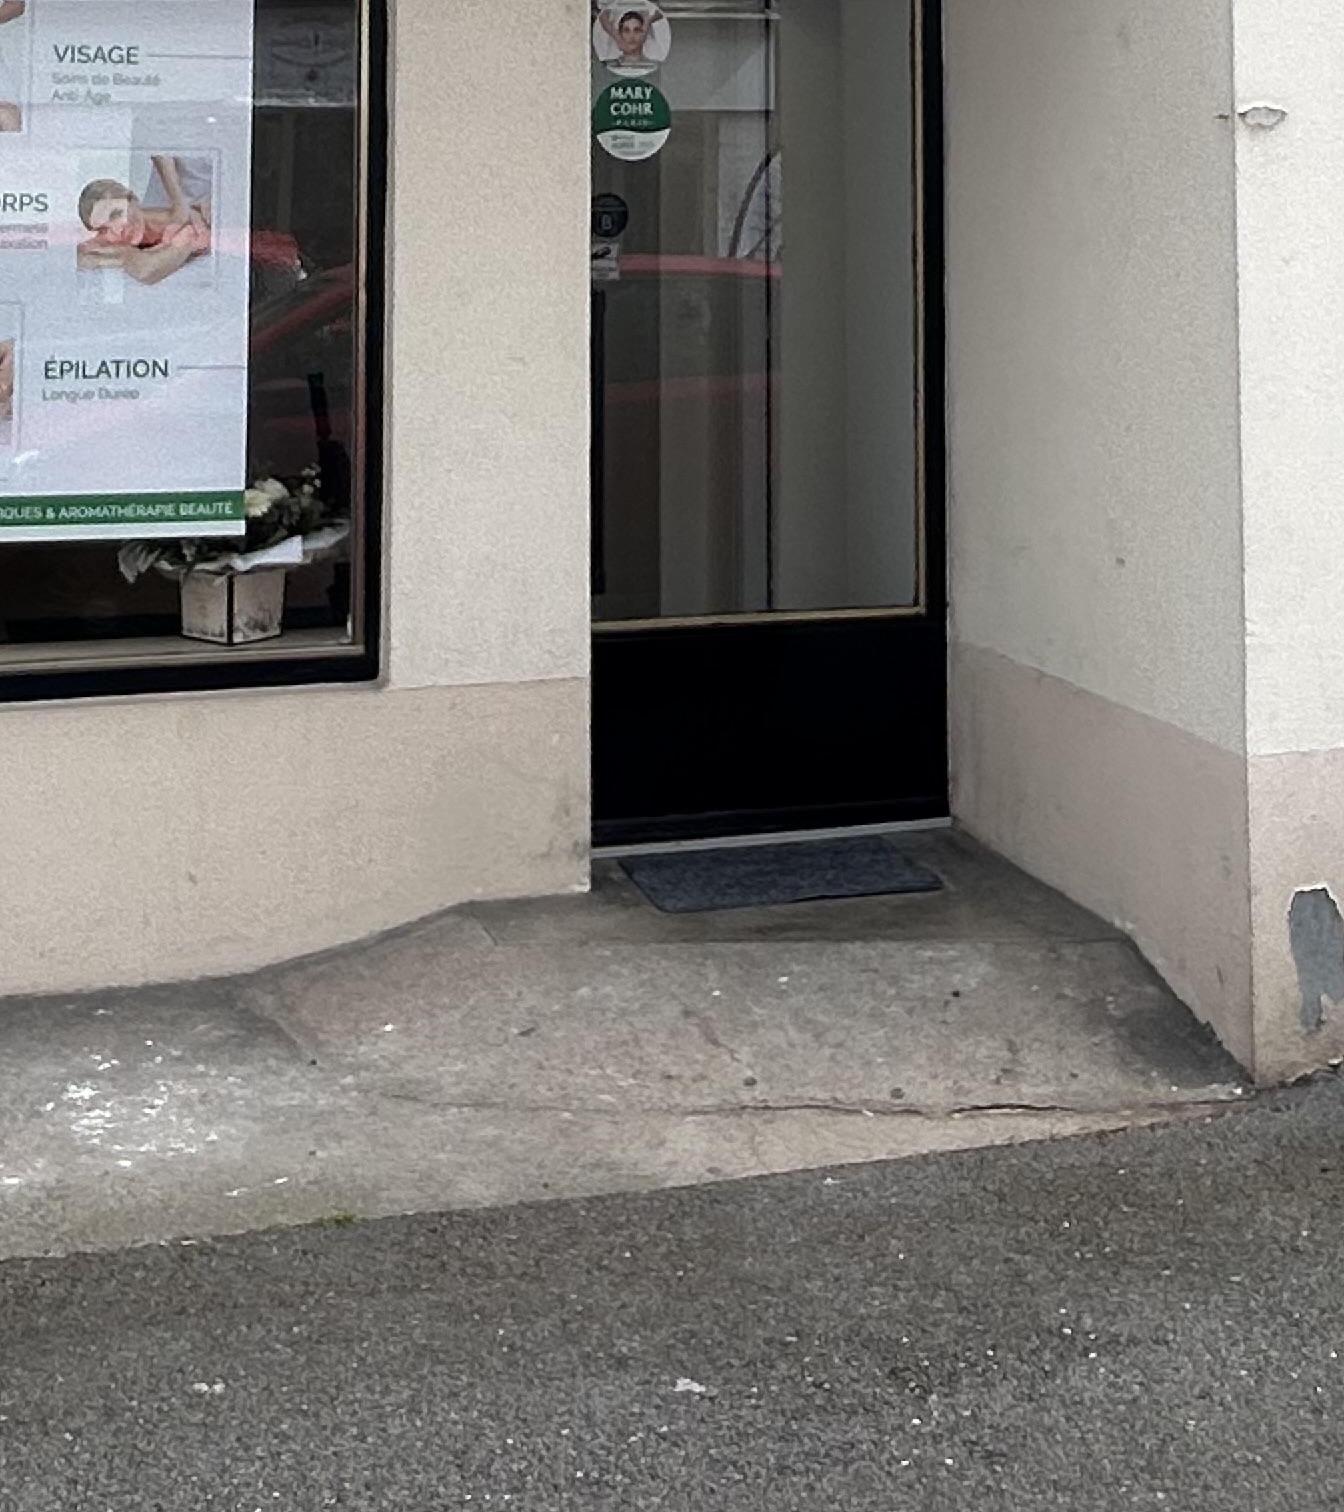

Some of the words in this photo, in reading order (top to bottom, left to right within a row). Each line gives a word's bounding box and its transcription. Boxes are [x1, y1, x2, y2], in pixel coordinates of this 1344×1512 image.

[53, 44, 140, 65] VISAGE
[611, 87, 654, 99] MARY
[610, 103, 654, 116] COHR
[44, 355, 169, 380] ÉPILATION
[181, 500, 233, 517] BEAUTÉ
